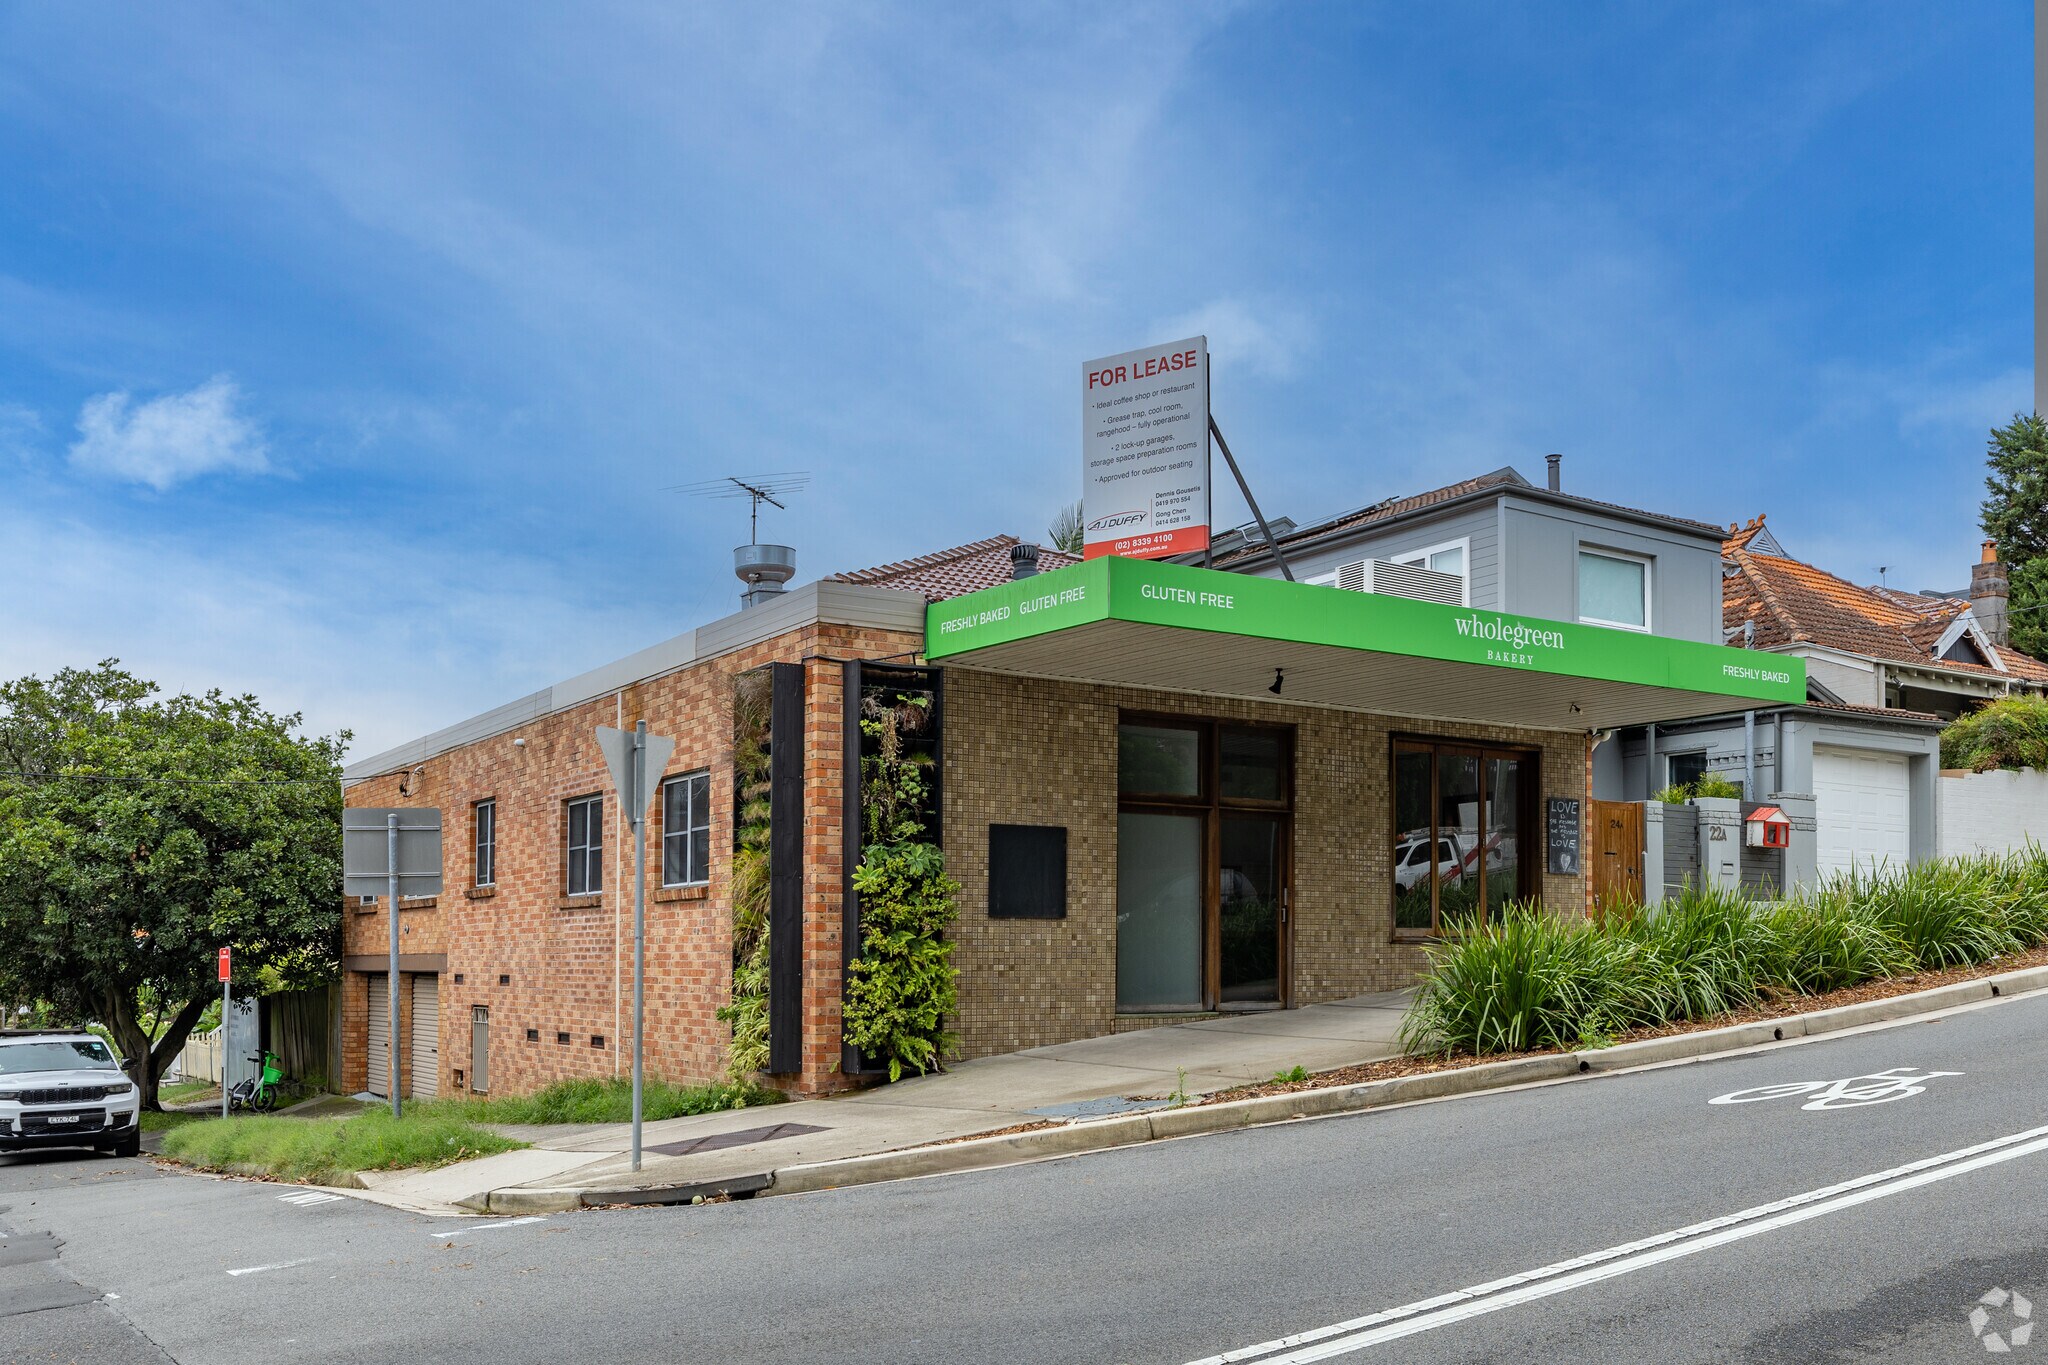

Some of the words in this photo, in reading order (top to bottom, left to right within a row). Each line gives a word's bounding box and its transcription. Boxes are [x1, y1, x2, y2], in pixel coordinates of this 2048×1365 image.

[1089, 366, 1127, 389] FOR
[1133, 350, 1197, 380] LEASE
[1096, 399, 1112, 409] Ideal
[1113, 395, 1134, 406] coffee
[1134, 392, 1151, 402] shop
[1160, 382, 1195, 395] restaurant
[1107, 413, 1131, 425] Grease
[1132, 410, 1147, 419] trap,
[1148, 406, 1162, 415] cool
[1163, 403, 1184, 412] room,
[1096, 425, 1131, 438] rangehood
[1138, 420, 1152, 430] fully
[1152, 412, 1191, 426] operational
[1121, 439, 1145, 450] lock-up
[1146, 433, 1175, 446] garages,
[1090, 456, 1115, 468] storage
[1115, 453, 1136, 464] space
[1136, 446, 1175, 460] preparation
[1176, 441, 1198, 451] rooms
[1098, 470, 1130, 484] Approved
[1131, 469, 1140, 477] for
[1141, 463, 1167, 476] outdoor
[1168, 460, 1193, 471] seating
[1155, 490, 1175, 499] Dennis
[1176, 486, 1201, 495] Gousetis
[1155, 499, 1169, 507] 0419
[1170, 497, 1180, 505] 970
[1108, 513, 1147, 528] DUFFY
[1155, 510, 1171, 518] Gong
[1172, 507, 1187, 515] Chen
[1155, 518, 1169, 526] 0414
[1115, 541, 1131, 551] (02)
[1132, 537, 1152, 547] 8339
[1153, 533, 1173, 543] 4100
[1141, 584, 1196, 605] GLUTEN
[1200, 592, 1234, 610] FREE
[941, 614, 979, 635] FRESHLY
[979, 606, 1011, 626] BAKED
[1019, 593, 1058, 615] GLUTEN
[1059, 586, 1086, 606] FREE
[1454, 614, 1565, 650] wholegreen
[1487, 650, 1534, 666] BAKERY
[1722, 664, 1761, 680] FRESHLY
[1761, 669, 1790, 684] BAKED
[1551, 800, 1579, 815] LOVE
[1610, 819, 1624, 829] 24A
[1709, 826, 1727, 842] 22A
[1551, 837, 1577, 849] LOVE
